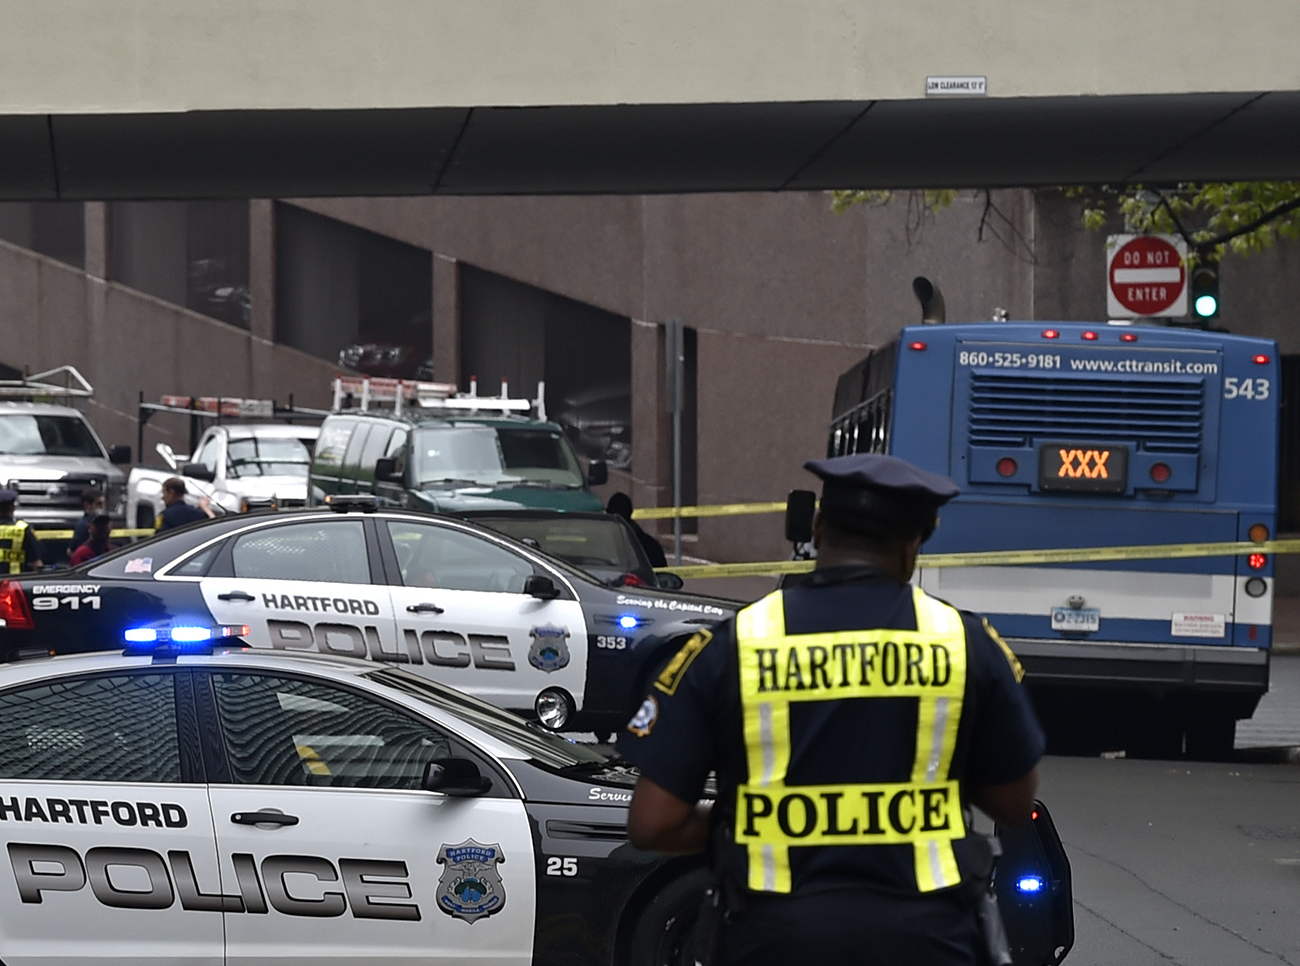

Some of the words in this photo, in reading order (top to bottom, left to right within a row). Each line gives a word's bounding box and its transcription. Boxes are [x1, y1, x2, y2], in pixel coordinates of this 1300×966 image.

[928, 81, 939, 90] LOW
[940, 81, 970, 90] CLEARANCE
[1123, 251, 1140, 265] DO
[1147, 250, 1170, 264] NOT
[1127, 286, 1167, 301] ENTER
[1071, 358, 1218, 374] www.cttransit.com
[1223, 377, 1270, 400] 543
[1058, 449, 1110, 478] XXX
[32, 584, 101, 594] EMERGENCY
[32, 596, 101, 610] 911
[261, 593, 380, 616] HARTFORD
[617, 595, 652, 609] Serving
[655, 599, 668, 609] the
[669, 600, 702, 613] Capital
[704, 605, 723, 616] City
[266, 619, 515, 672] POLICE
[597, 636, 627, 649] 353
[755, 642, 951, 692] HARTFORD
[742, 788, 950, 838] POLICE
[450, 848, 491, 857] HARTFORD
[546, 857, 578, 876] 25
[7, 842, 422, 921] POLICE
